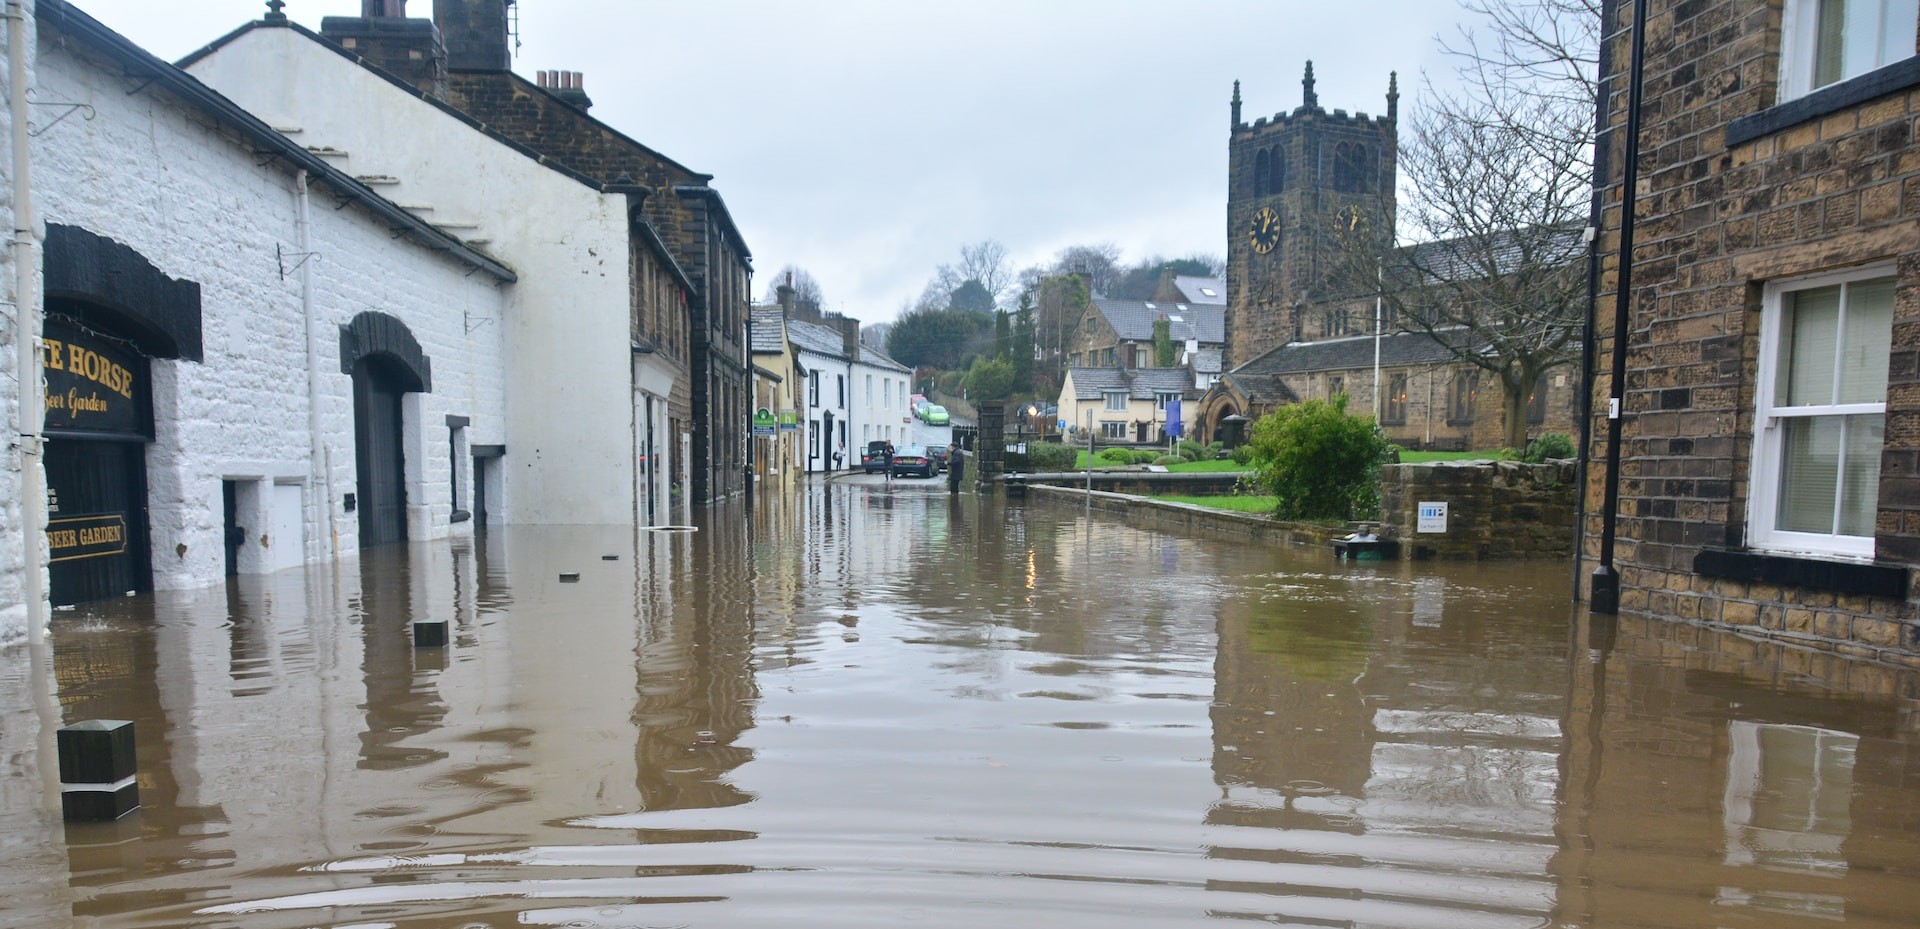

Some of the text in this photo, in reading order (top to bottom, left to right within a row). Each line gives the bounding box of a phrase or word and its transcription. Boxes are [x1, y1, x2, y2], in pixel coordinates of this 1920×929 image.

[68, 344, 132, 400] HORSE
[68, 387, 107, 419] Garden
[47, 525, 120, 549] BEER GARDEN
